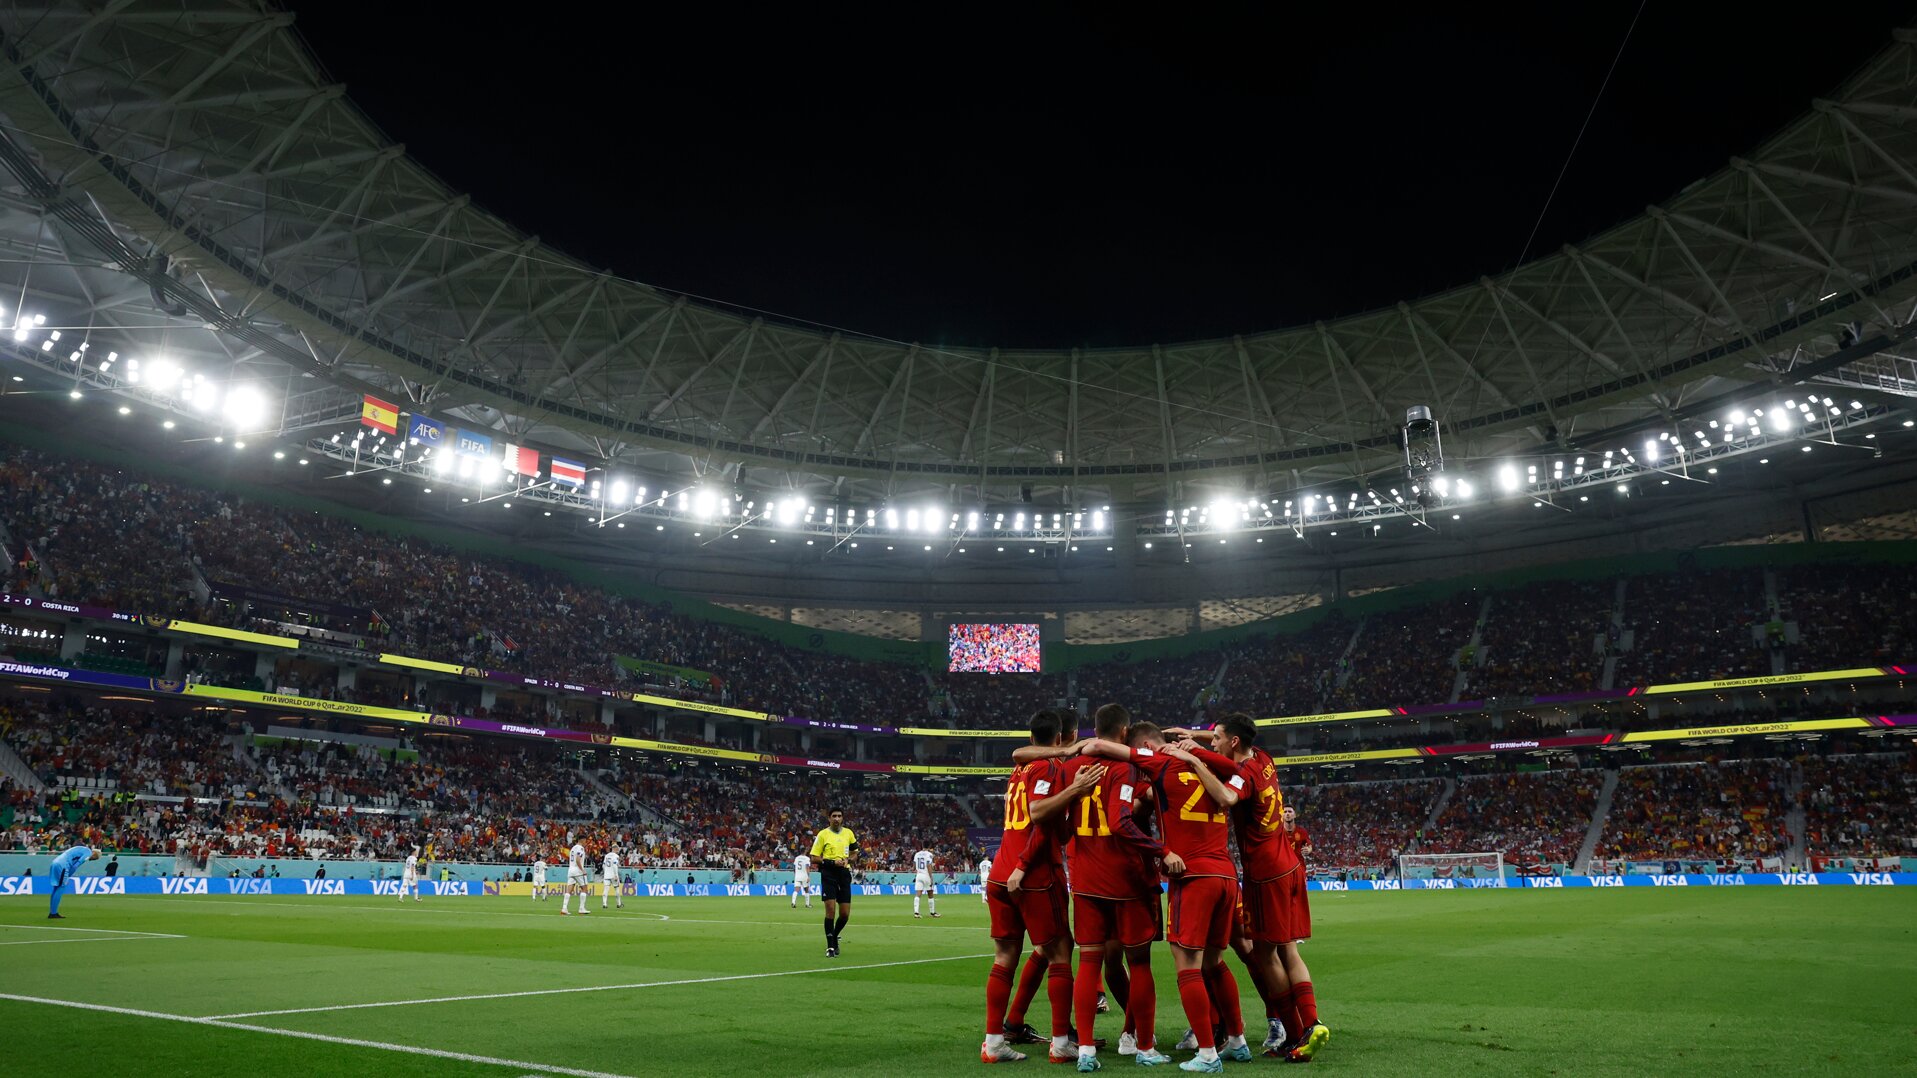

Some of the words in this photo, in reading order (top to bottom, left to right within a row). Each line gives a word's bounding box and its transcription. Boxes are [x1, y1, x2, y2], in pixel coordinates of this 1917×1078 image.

[414, 423, 438, 440] AFC
[461, 438, 485, 453] FIFA
[42, 602, 62, 610] COSTA
[278, 696, 302, 705] WORLD
[502, 725, 545, 736] #FIFAWorldCup
[1490, 741, 1539, 749] #FIFAWorldCup
[1005, 781, 1030, 830] 10
[1077, 785, 1112, 836] 11
[798, 861, 802, 870] 5
[917, 857, 925, 870] 16
[1369, 880, 1400, 889] VISA
[1422, 879, 1454, 888] VISA
[1528, 877, 1563, 887] VISA
[1588, 876, 1624, 886] VISA
[1649, 875, 1688, 885] VISA
[1705, 875, 1745, 885] VISA
[1776, 874, 1819, 885] VISA
[1848, 874, 1894, 885] VISA
[0, 877, 33, 894] SA
[69, 877, 125, 894] VISA
[158, 878, 208, 894] VISA
[226, 879, 272, 894] VISA
[302, 879, 345, 895] VISA
[432, 881, 468, 895] VISA
[646, 884, 674, 896] VISA
[683, 885, 709, 896] VISA
[724, 884, 750, 896] VISA
[763, 885, 787, 896] VISA
[861, 885, 880, 895] VISA
[892, 885, 910, 894] VISA
[944, 885, 960, 894] VISA
[970, 885, 982, 894] VIS
